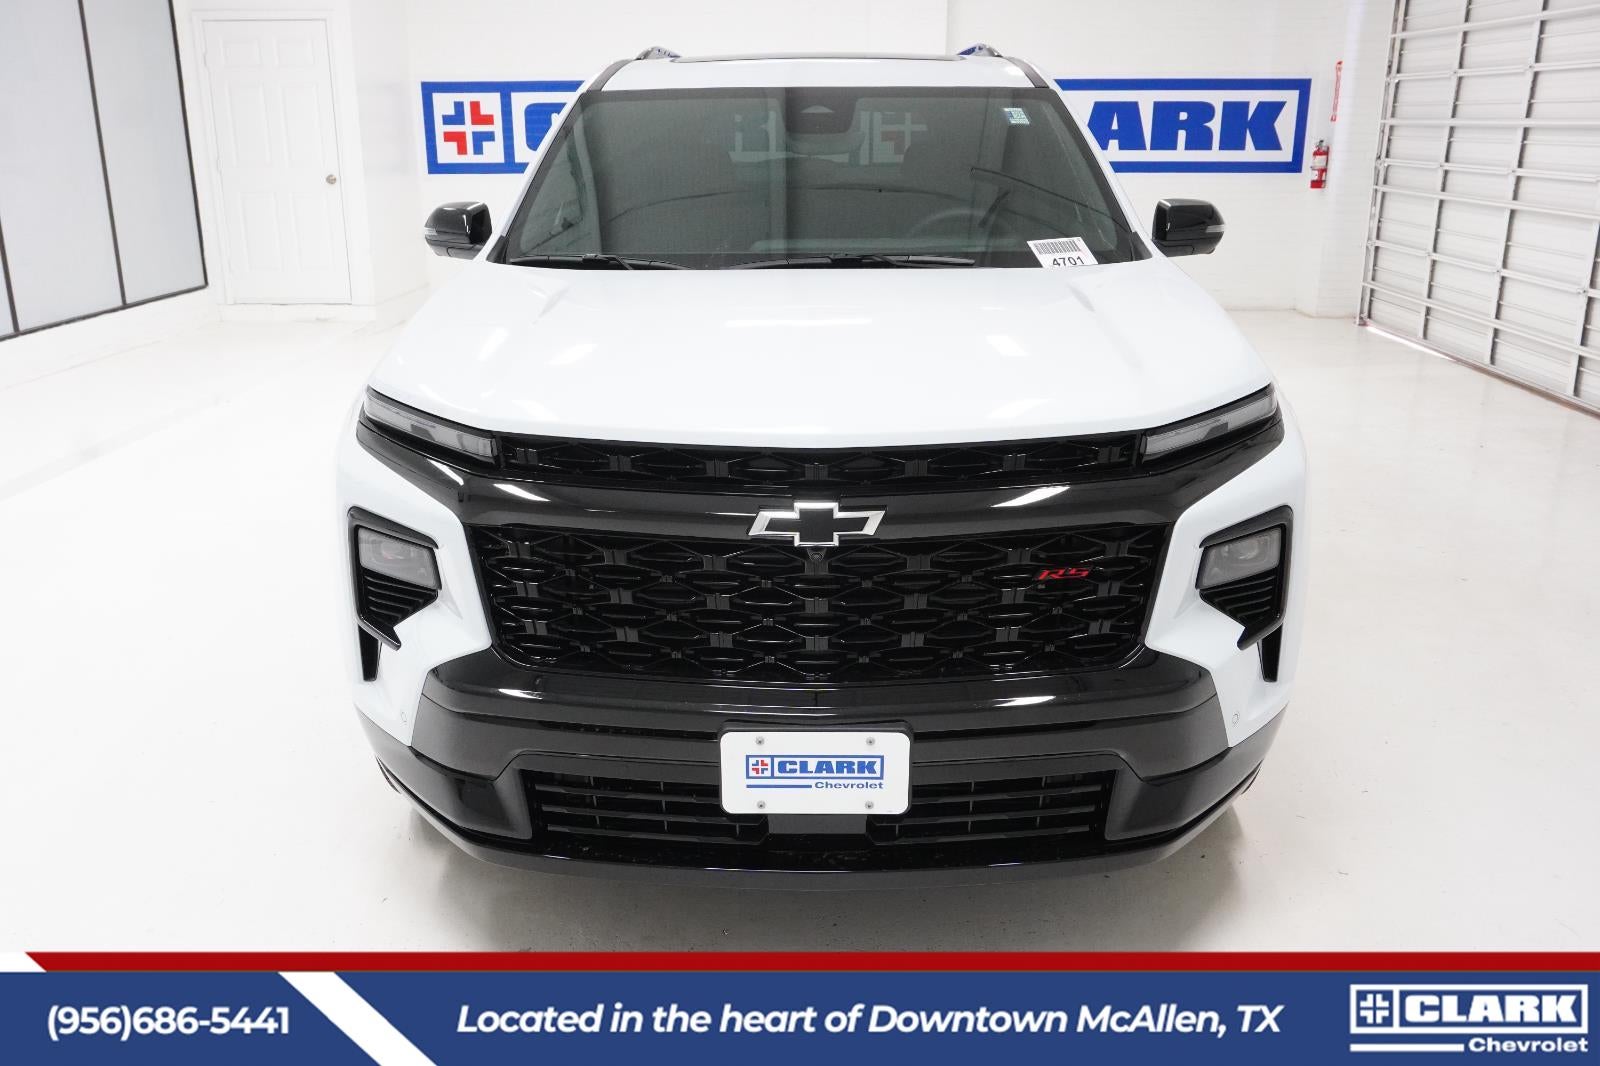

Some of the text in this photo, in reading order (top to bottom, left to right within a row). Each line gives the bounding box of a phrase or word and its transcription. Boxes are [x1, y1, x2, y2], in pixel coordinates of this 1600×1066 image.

[1052, 255, 1085, 267] 4701
[1037, 567, 1090, 580] RS
[777, 759, 877, 775] CLARK
[814, 781, 884, 790] Chevrolet
